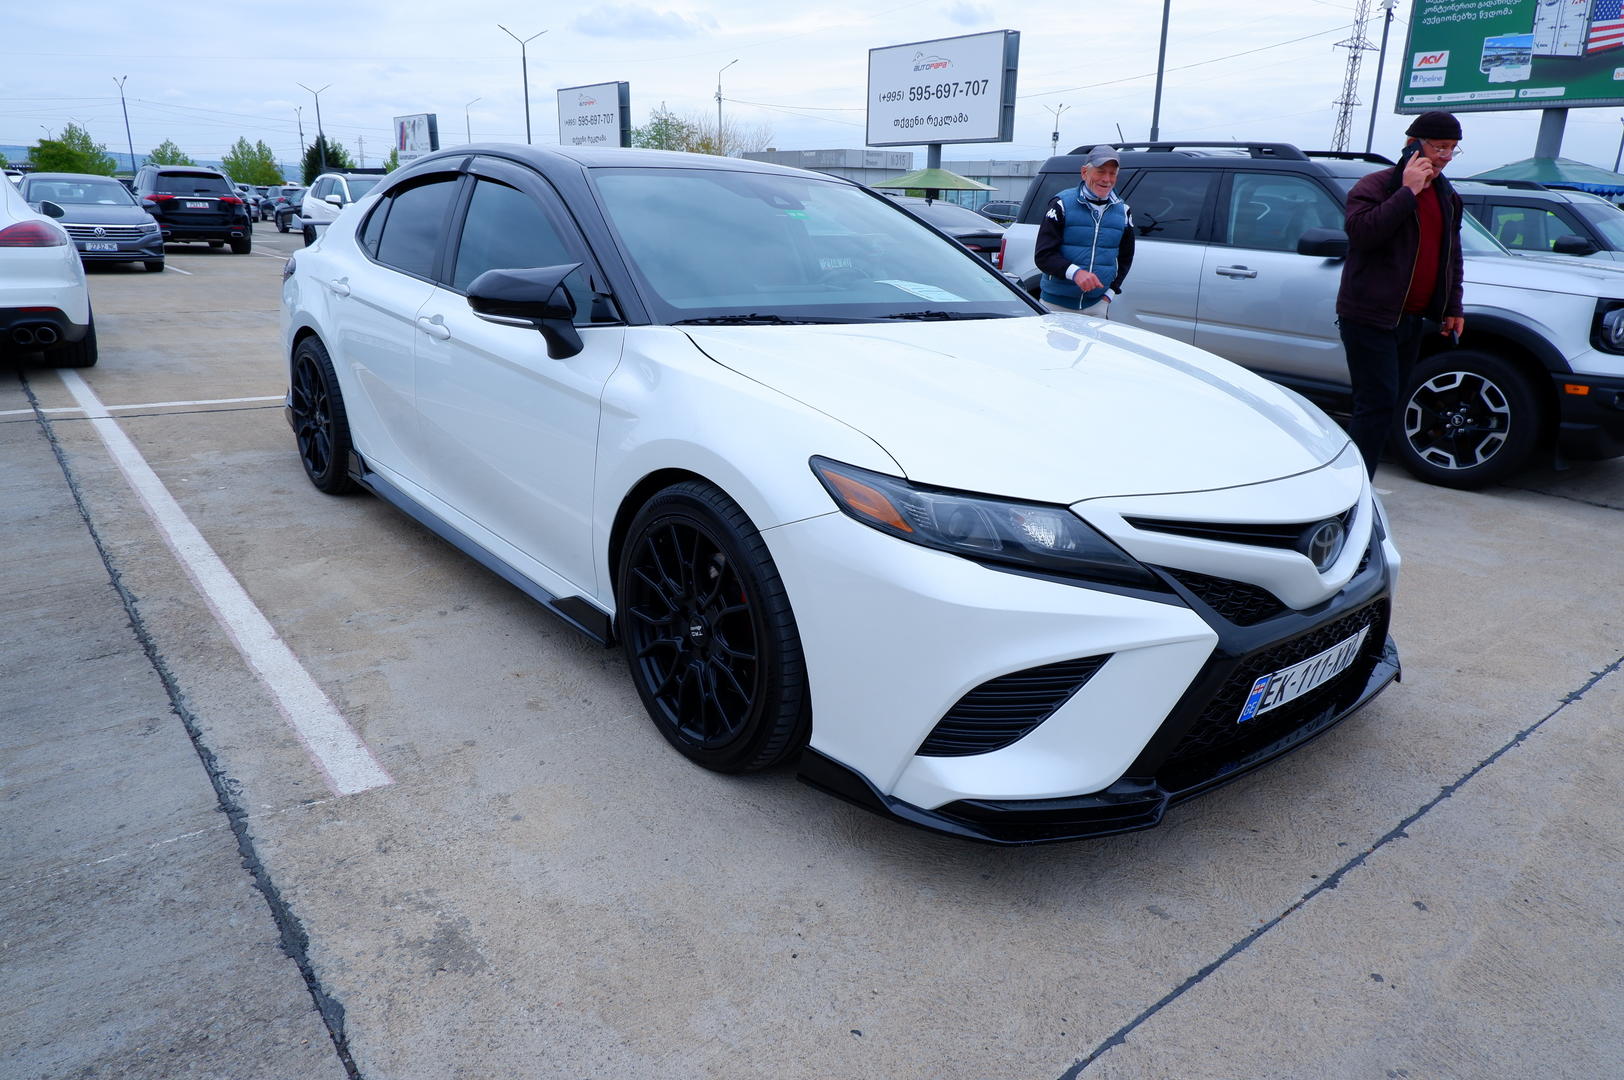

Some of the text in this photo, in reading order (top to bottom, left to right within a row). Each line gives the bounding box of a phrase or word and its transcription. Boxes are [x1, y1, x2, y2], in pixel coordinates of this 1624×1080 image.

[878, 79, 989, 103] (+995) 595-697-707
[893, 112, 969, 128] თქვენი რეკლამა
[1243, 701, 1258, 716] GE
